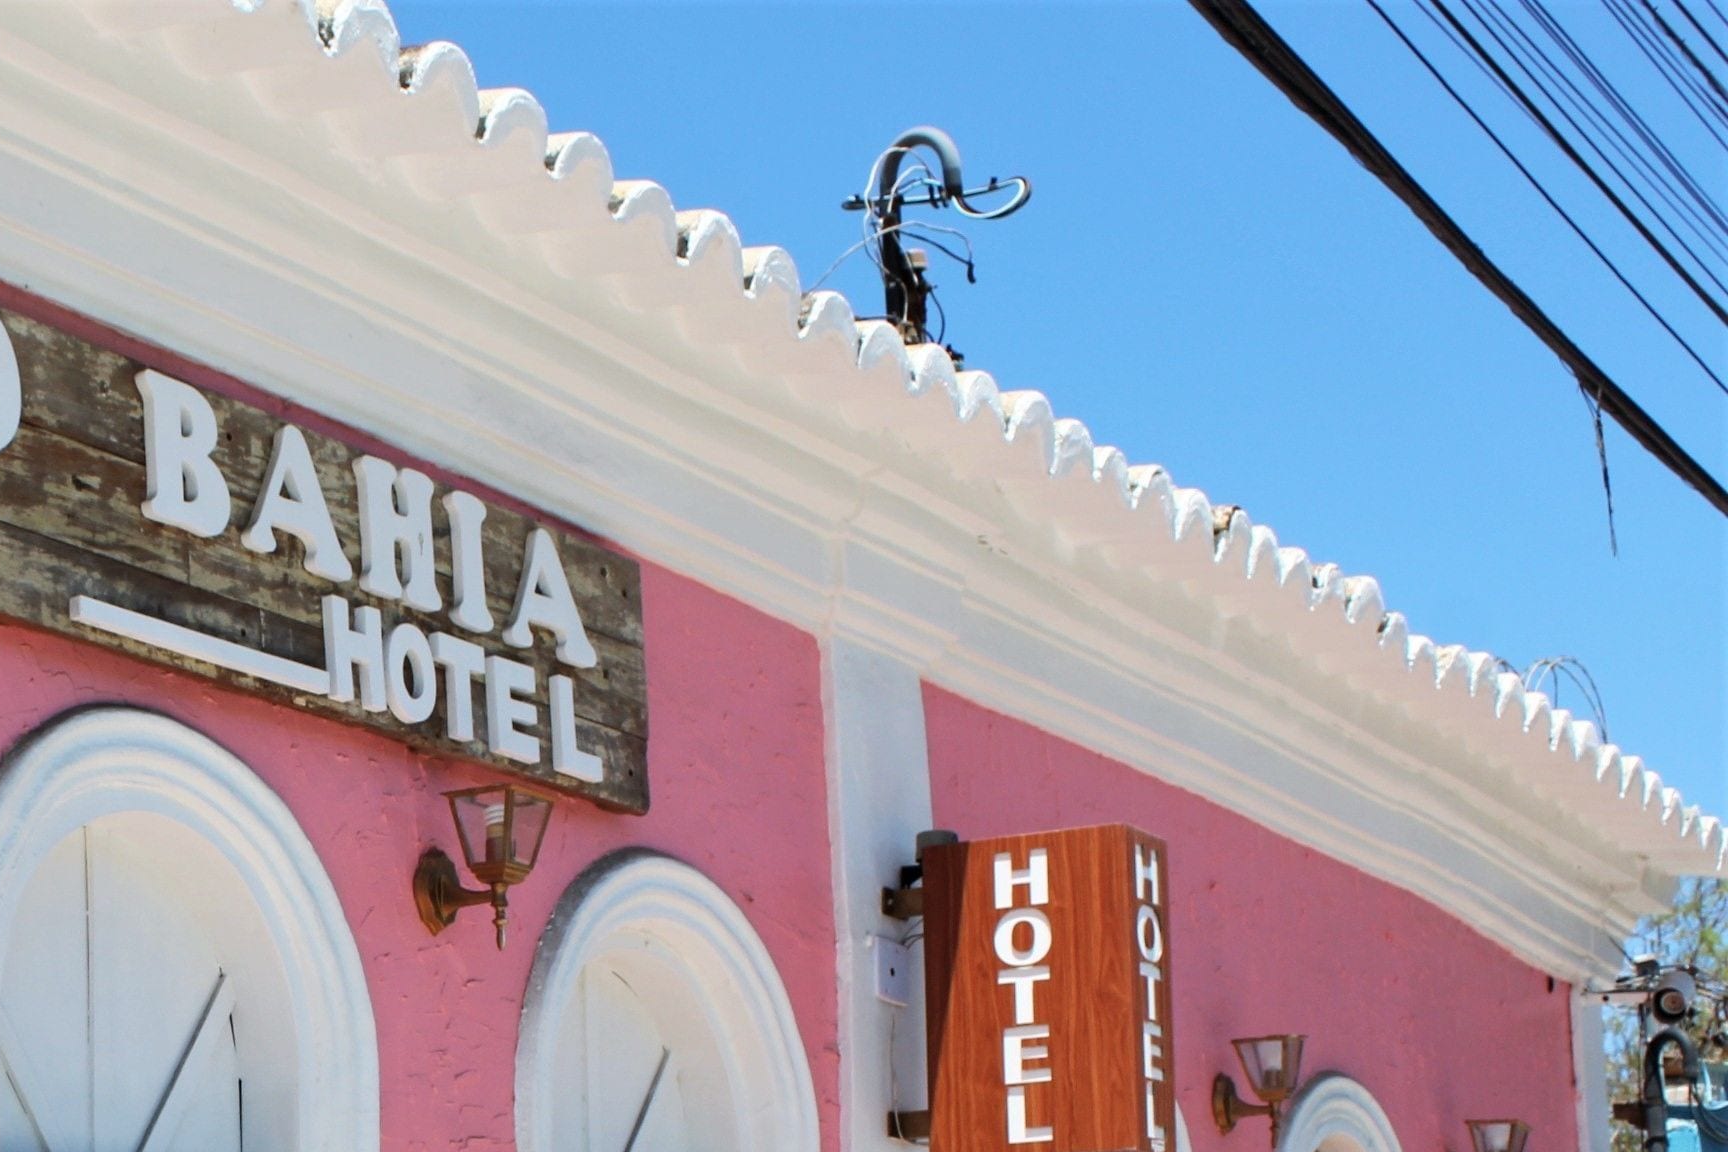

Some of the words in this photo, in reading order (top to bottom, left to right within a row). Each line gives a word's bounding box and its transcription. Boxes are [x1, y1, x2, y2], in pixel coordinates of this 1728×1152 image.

[135, 368, 597, 669] BAHIA
[321, 594, 604, 784] HOTEL
[992, 848, 1054, 1146] HOTEL
[1135, 843, 1166, 1140] HOTEL
